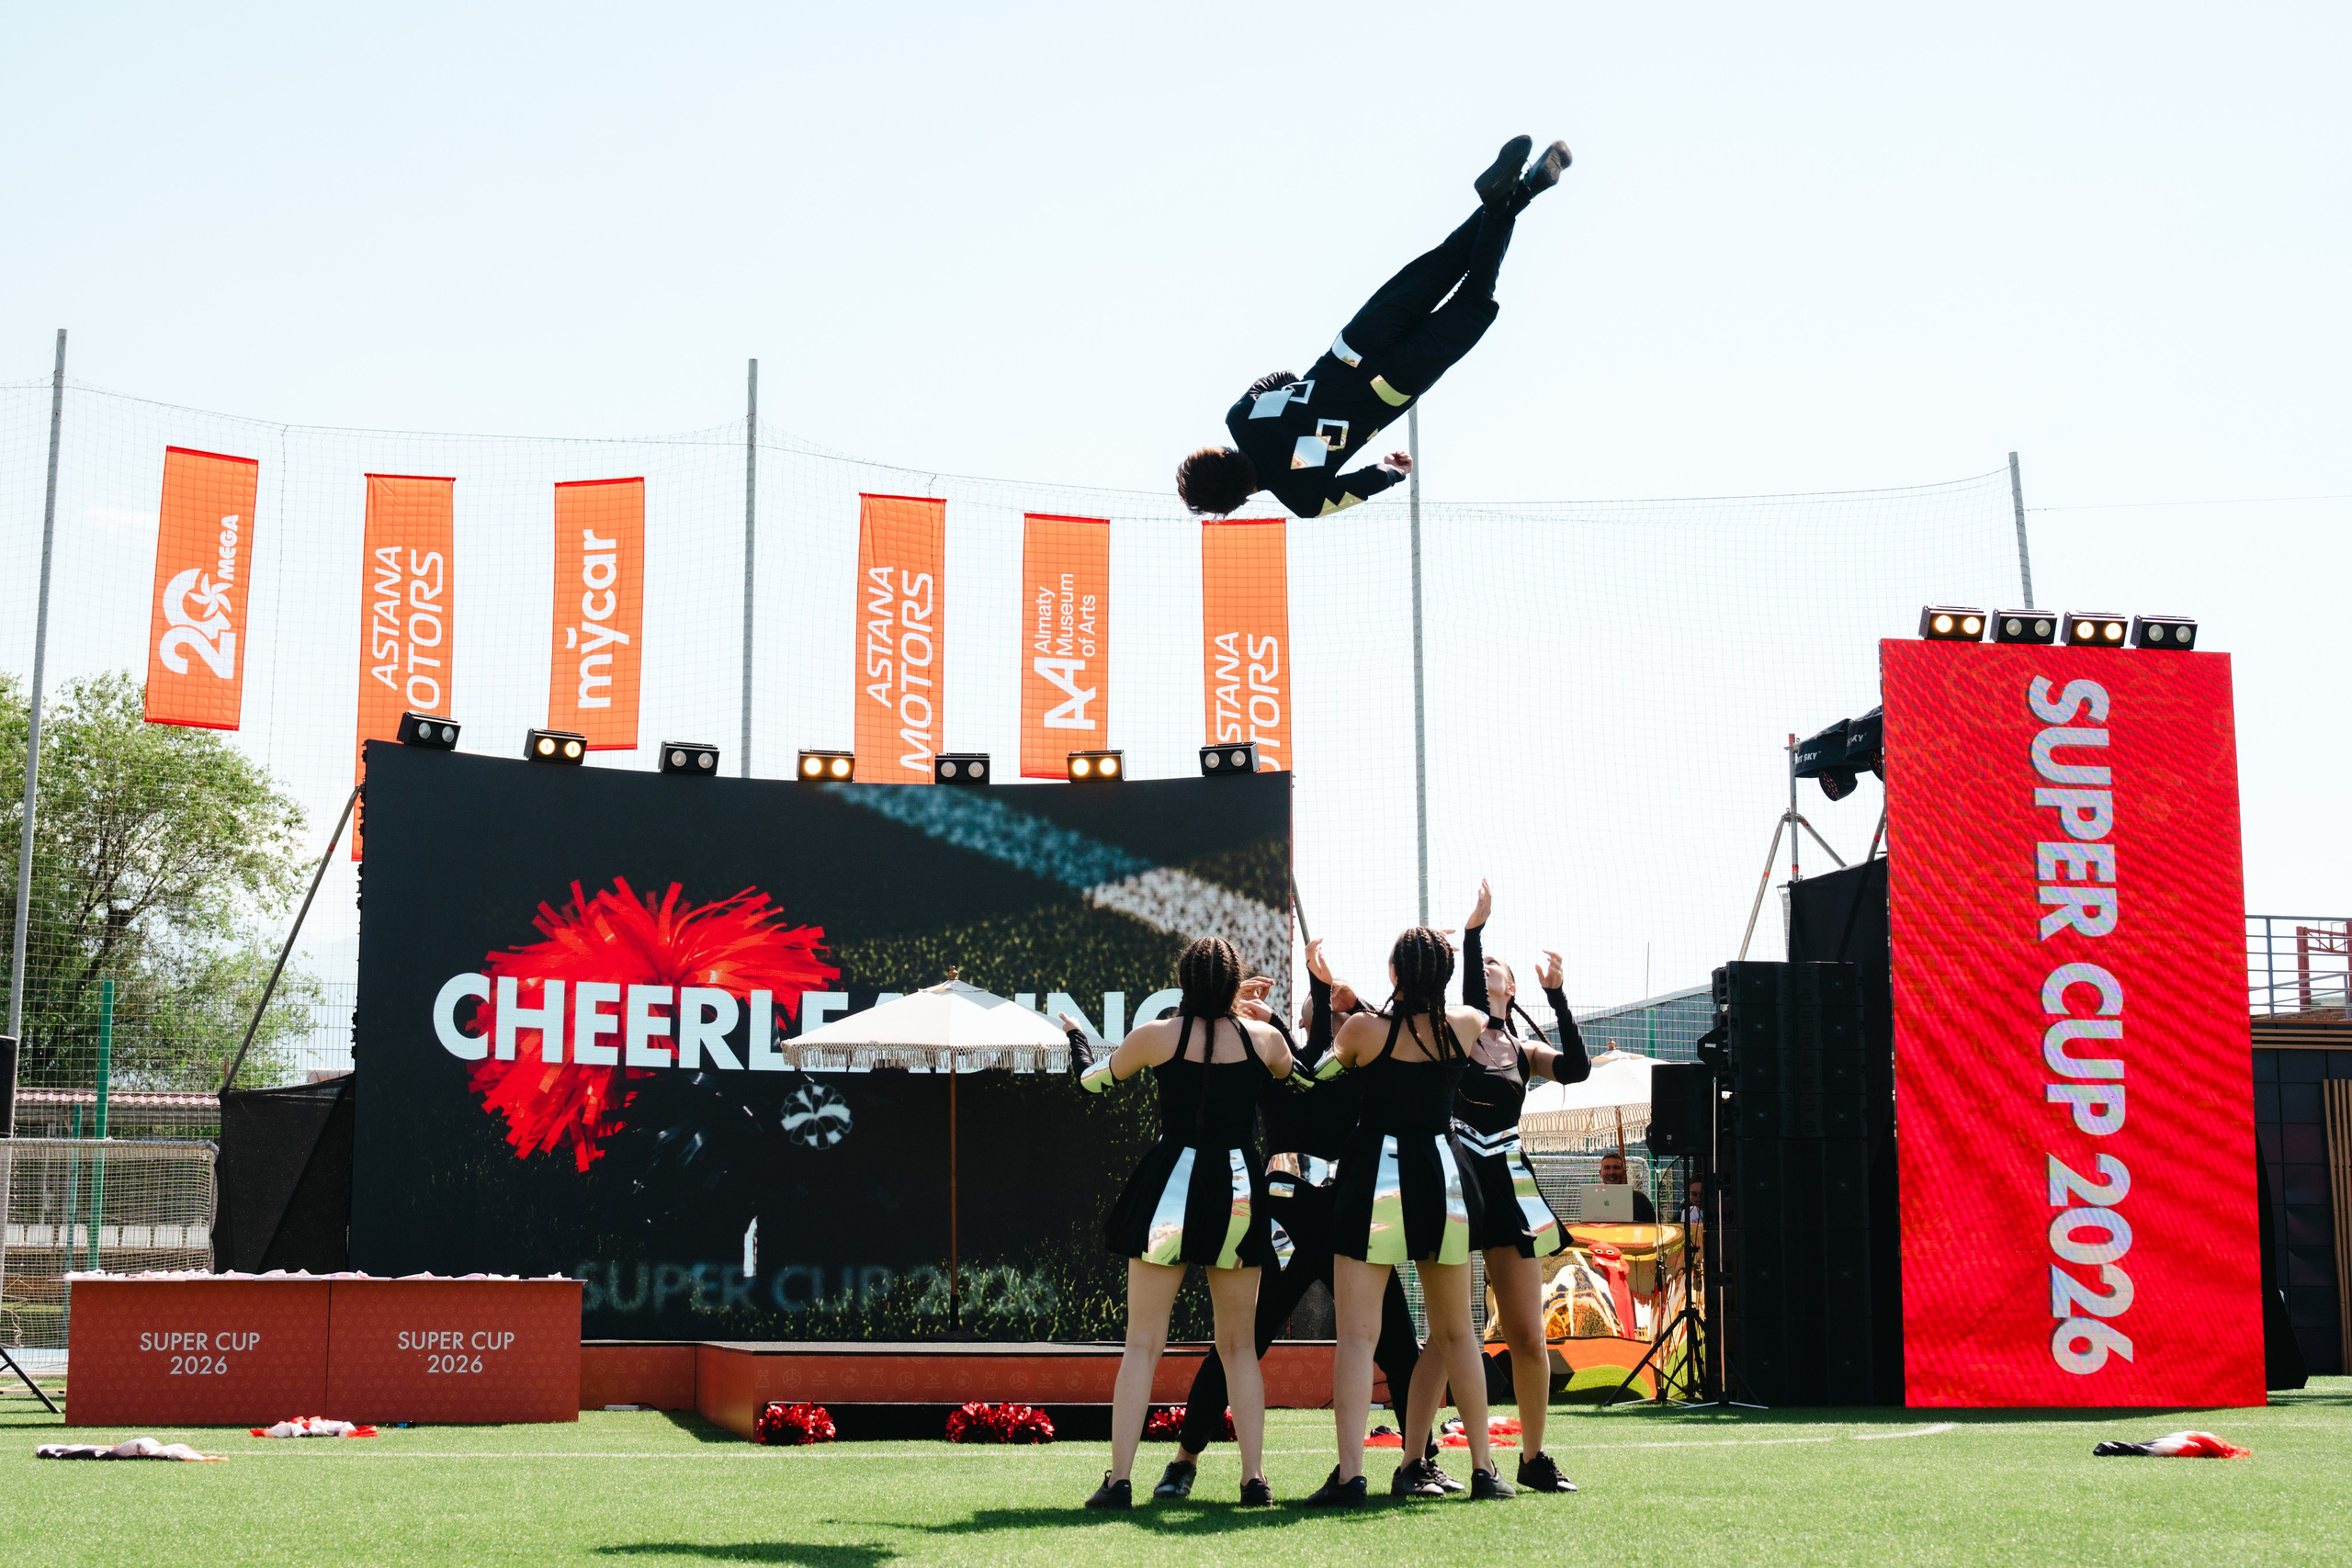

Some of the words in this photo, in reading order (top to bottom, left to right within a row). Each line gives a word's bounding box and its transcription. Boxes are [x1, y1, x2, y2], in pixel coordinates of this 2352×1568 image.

[217, 514, 239, 581] MEGA
[371, 546, 402, 691] ASTANA
[406, 548, 444, 711] OTORS
[866, 566, 894, 709] ASTANA
[1034, 585, 1056, 655] Almaty
[1056, 572, 1074, 657] Museum
[1079, 594, 1096, 636] Arts
[1079, 638, 1096, 658] of
[899, 570, 933, 773] MOTORS
[1214, 631, 1241, 743] STANA
[1247, 633, 1281, 772] TORS
[1804, 752, 1817, 761] SKY
[2027, 674, 2119, 942] SUPER
[2040, 962, 2126, 1136] CUP
[2045, 1152, 2135, 1376] 2026
[140, 1332, 208, 1351] SUPER
[215, 1332, 260, 1351] CUP
[169, 1355, 228, 1375] 2026
[398, 1331, 464, 1350] SUPER
[471, 1331, 515, 1350] CUP
[426, 1354, 483, 1374] 2026
